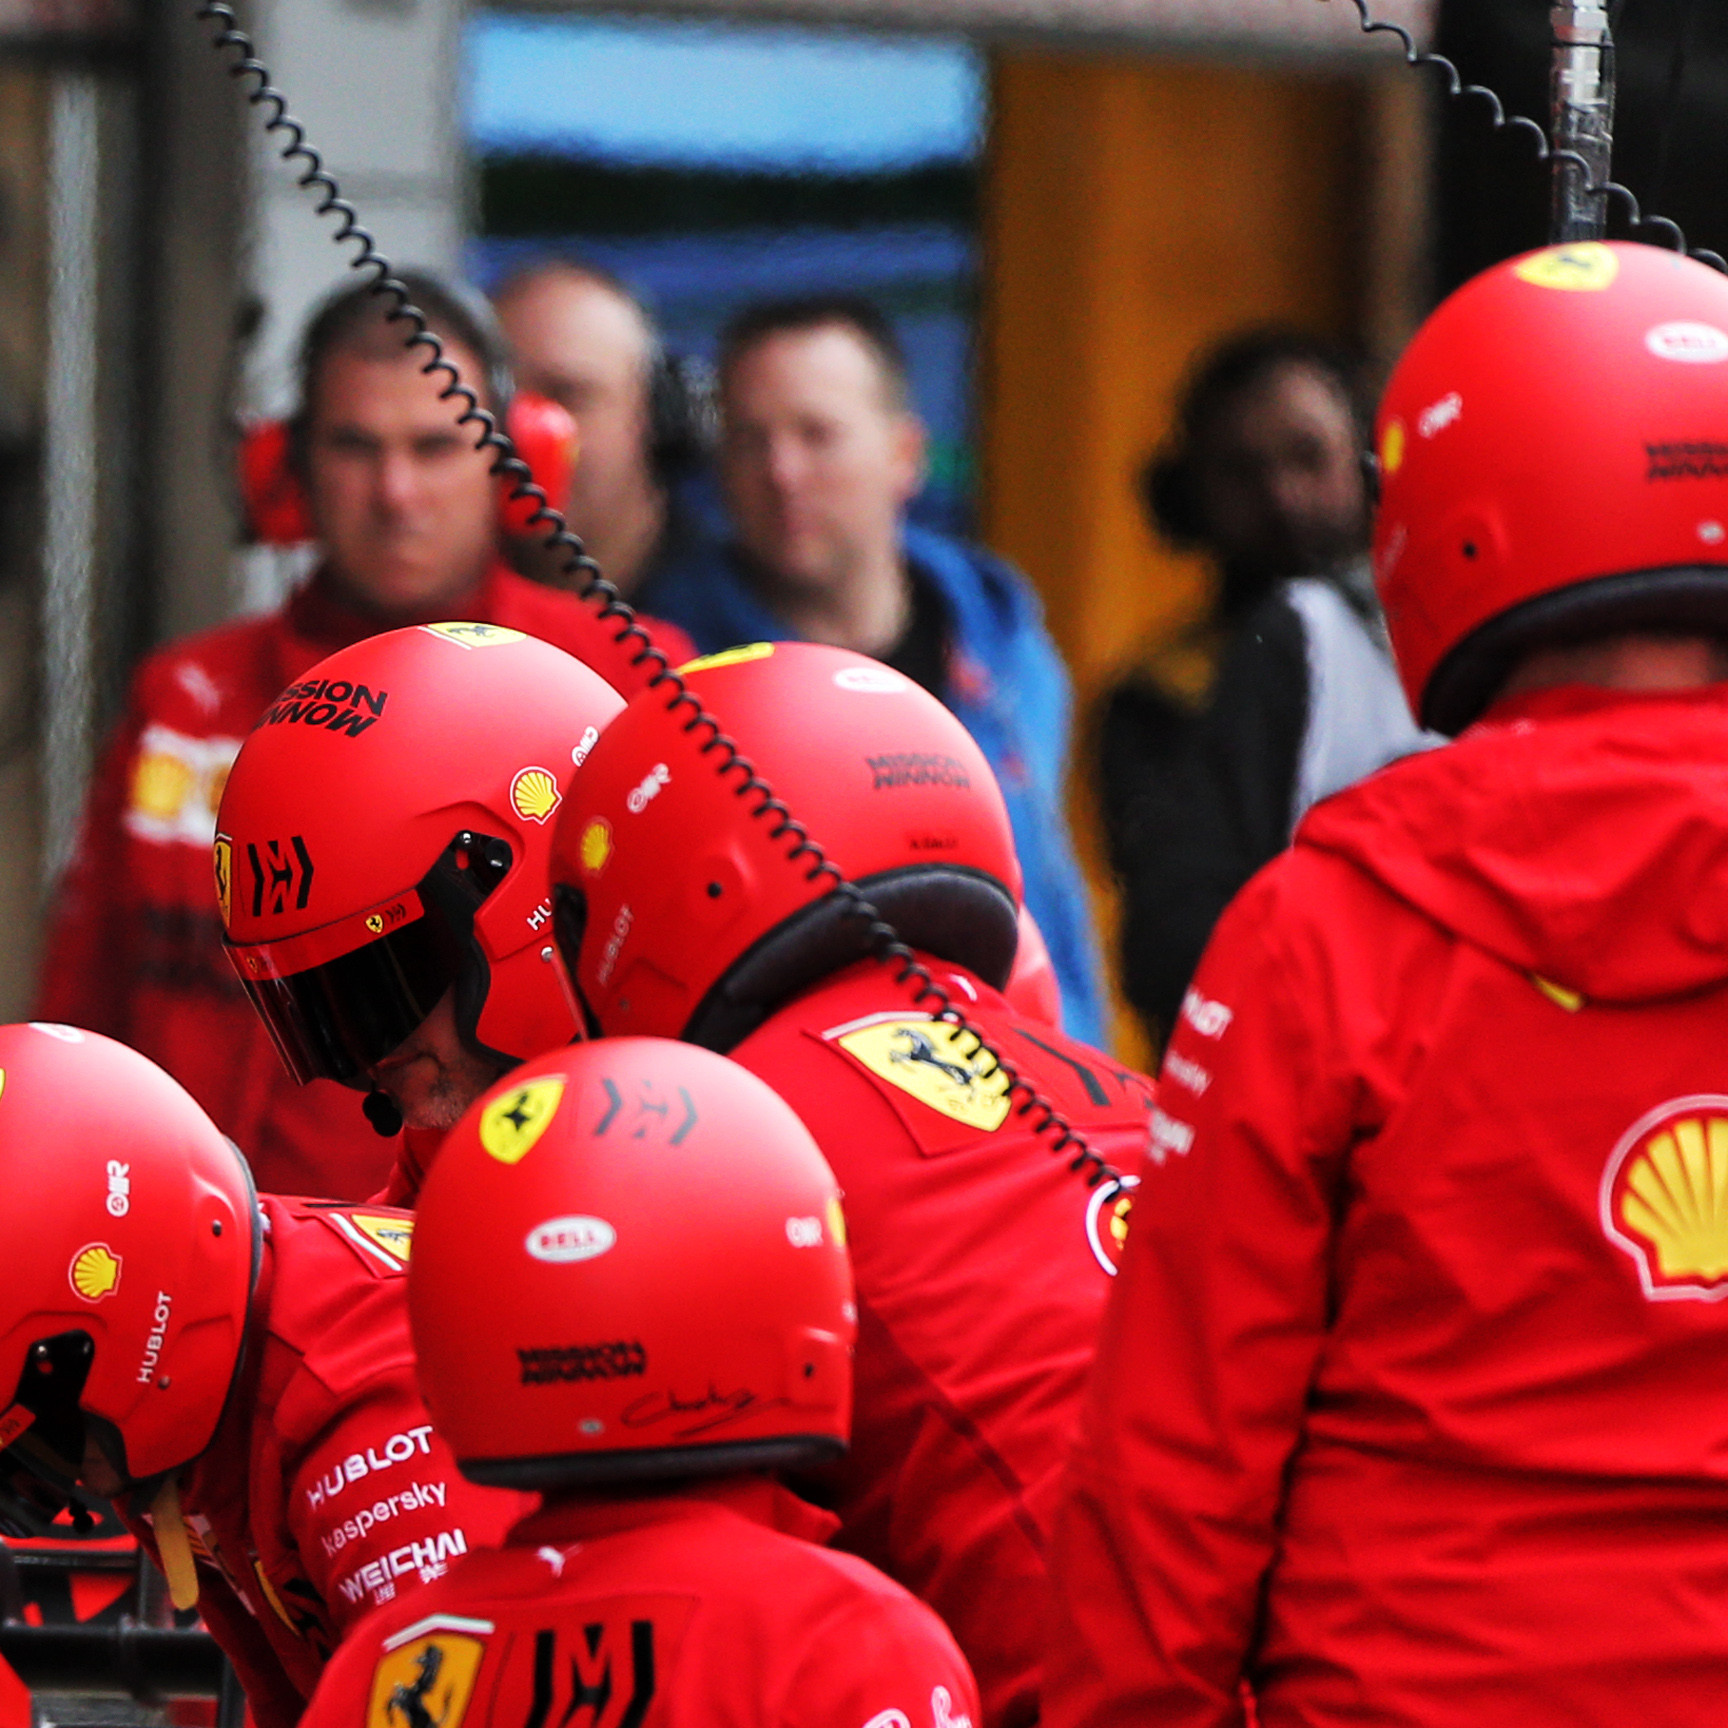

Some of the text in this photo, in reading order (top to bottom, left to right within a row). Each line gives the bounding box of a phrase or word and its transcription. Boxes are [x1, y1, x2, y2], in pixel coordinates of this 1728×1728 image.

[136, 1290, 173, 1384] HUBLOT
[306, 1425, 434, 1511] HUBLOT
[321, 1481, 446, 1558] kaspersky
[339, 1528, 468, 1604] WEICHAI
